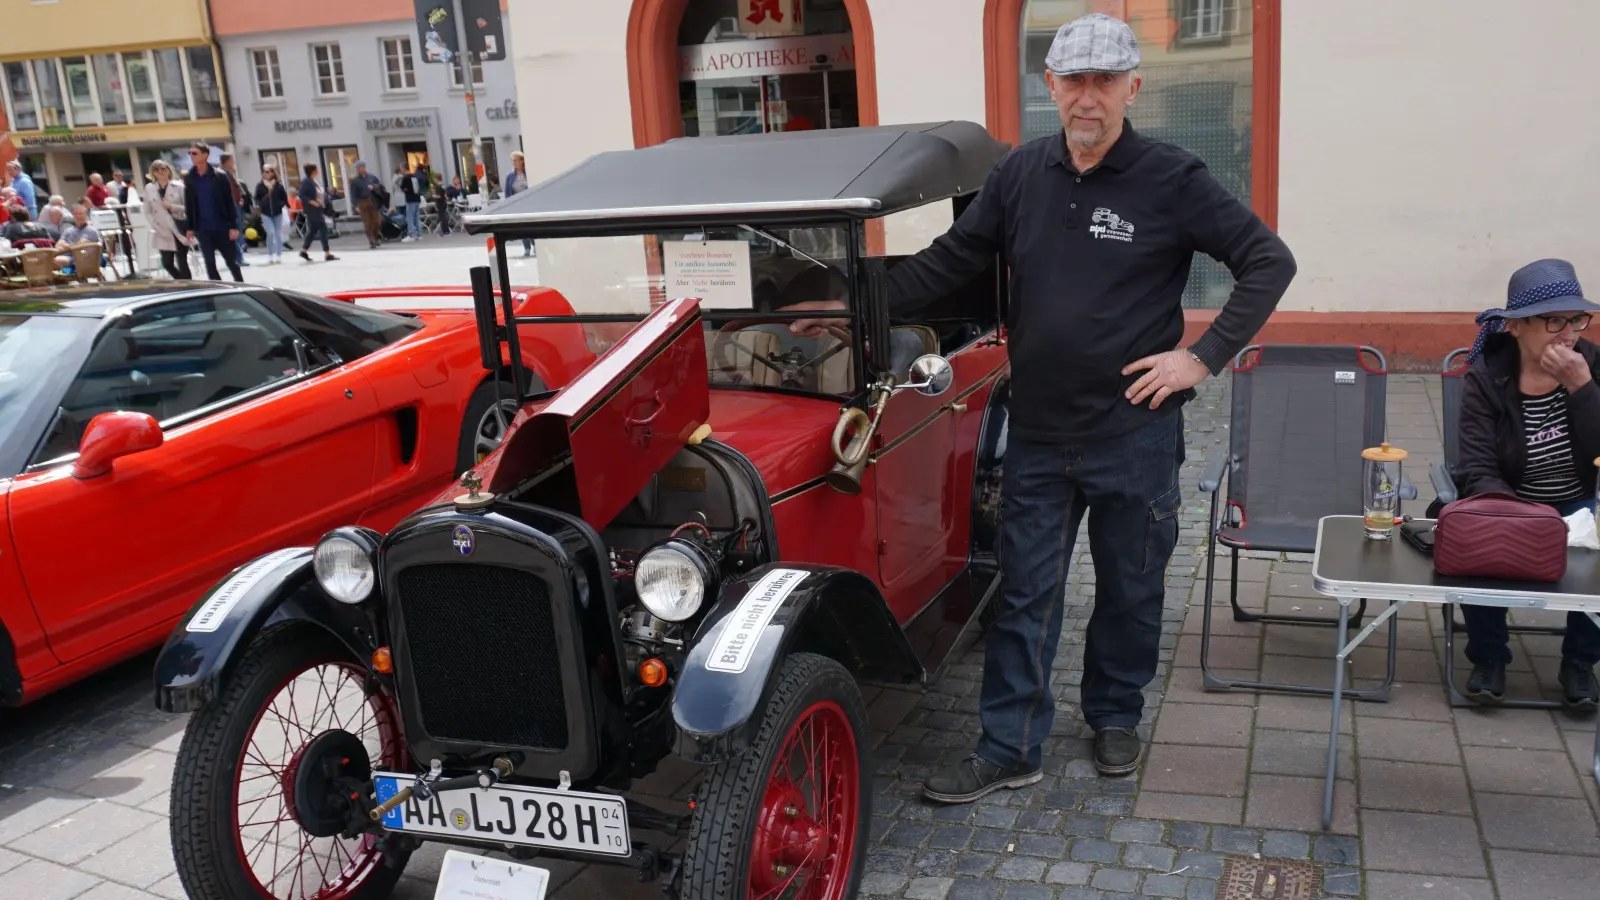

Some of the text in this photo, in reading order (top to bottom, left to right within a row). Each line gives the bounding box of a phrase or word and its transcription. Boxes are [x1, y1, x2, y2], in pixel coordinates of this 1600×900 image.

[486, 98, 519, 120] café
[720, 631, 749, 664] Bitte
[741, 602, 767, 630] nicht
[601, 807, 620, 821] 04
[606, 834, 623, 847] 10
